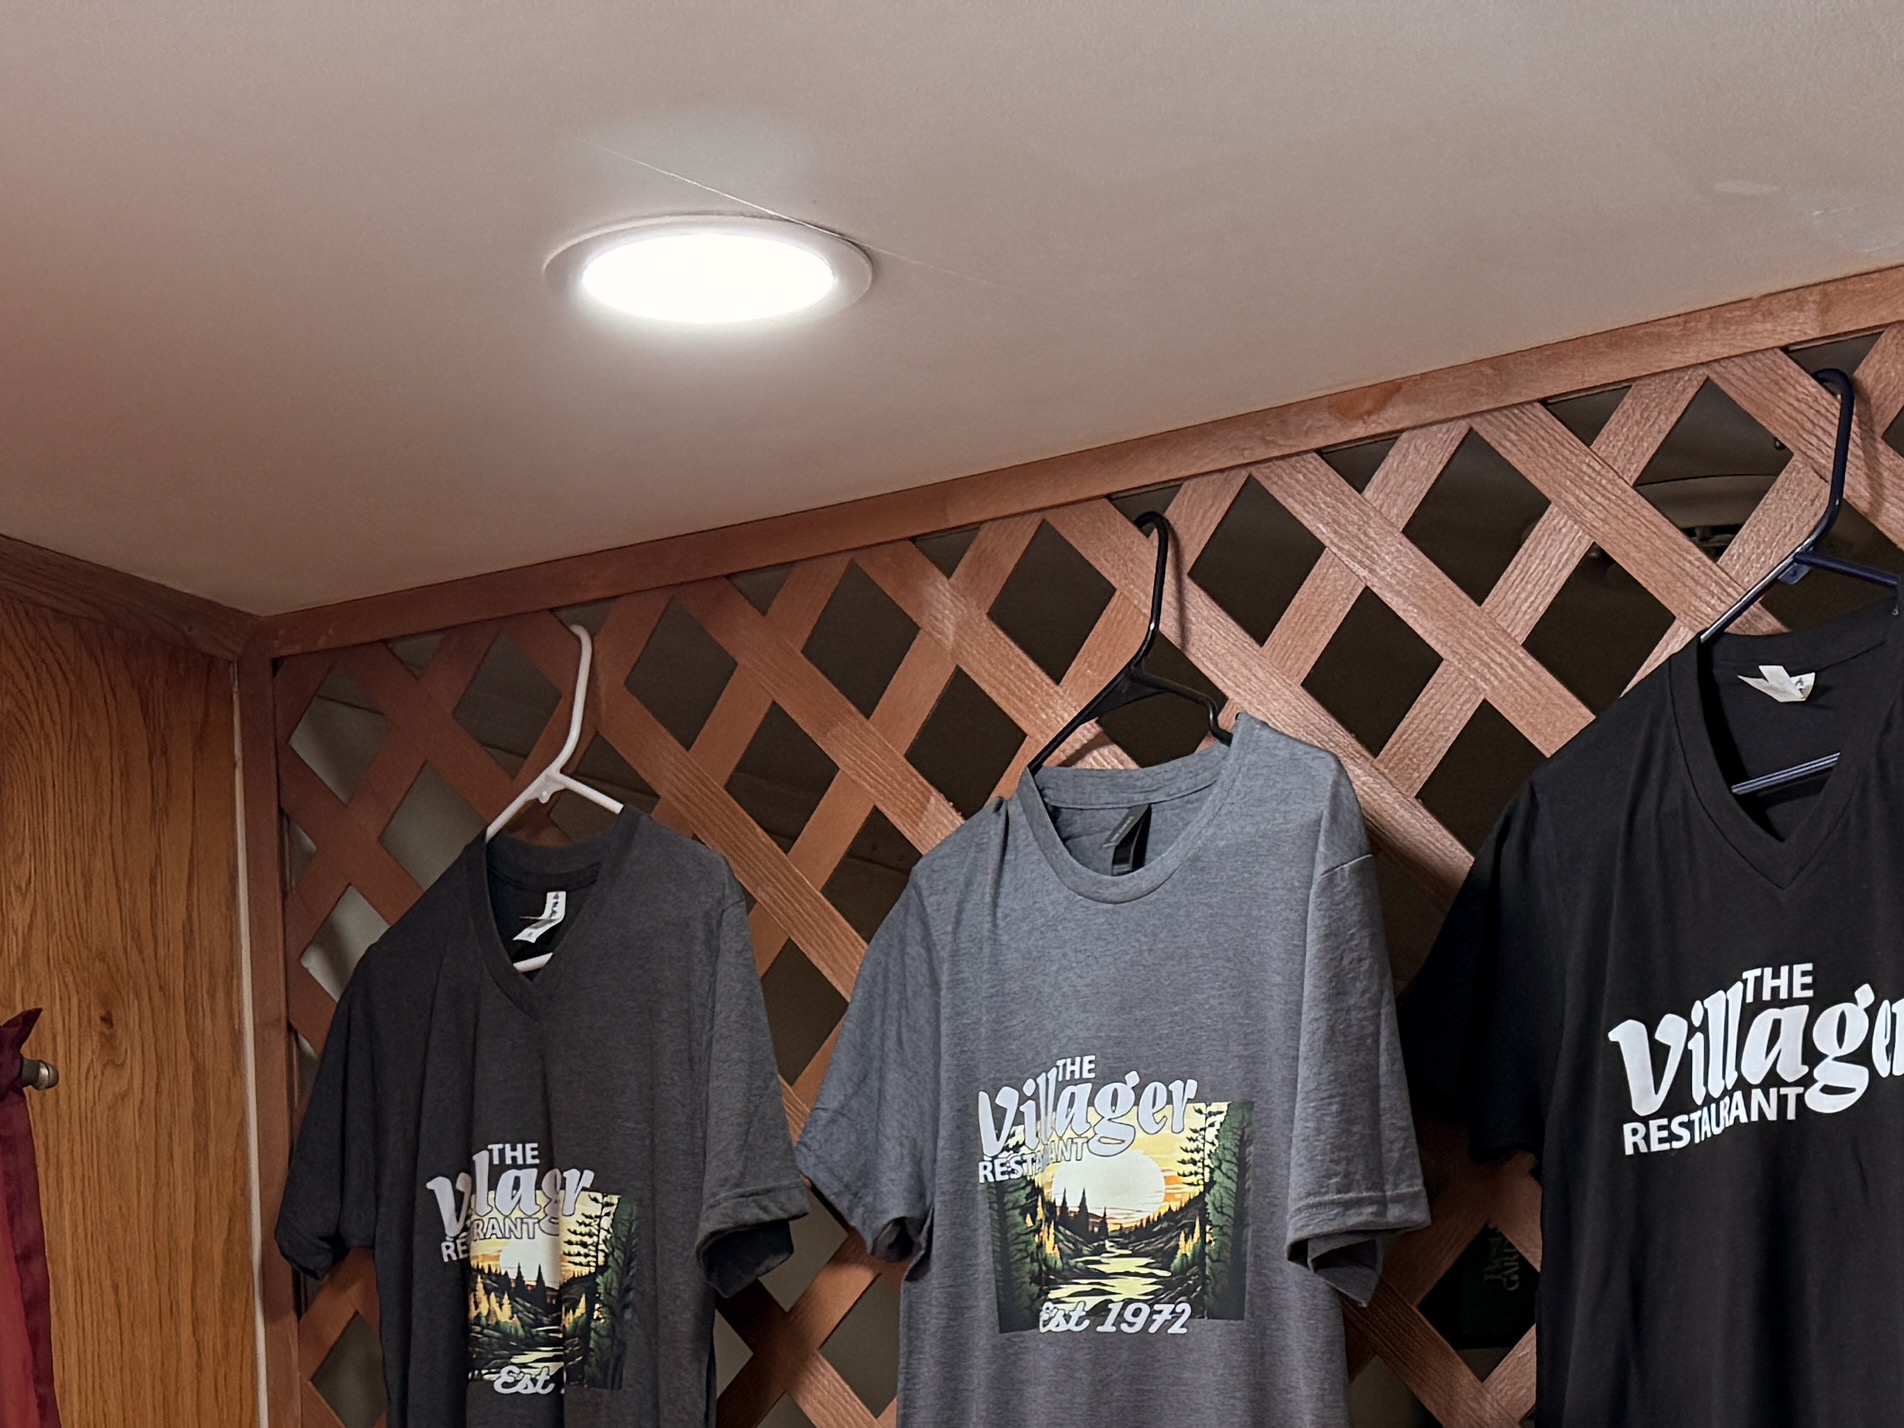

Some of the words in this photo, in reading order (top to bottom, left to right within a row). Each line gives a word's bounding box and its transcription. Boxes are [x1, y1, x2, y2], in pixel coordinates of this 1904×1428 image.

[1742, 963, 1814, 1003] THE
[1056, 1055, 1095, 1081] THE
[978, 1071, 1197, 1157] Villager
[1623, 1087, 1804, 1155] RESTAURANT
[488, 1143, 540, 1165] THE
[1096, 1302, 1192, 1334] 1972
[493, 1365, 555, 1394] Est
